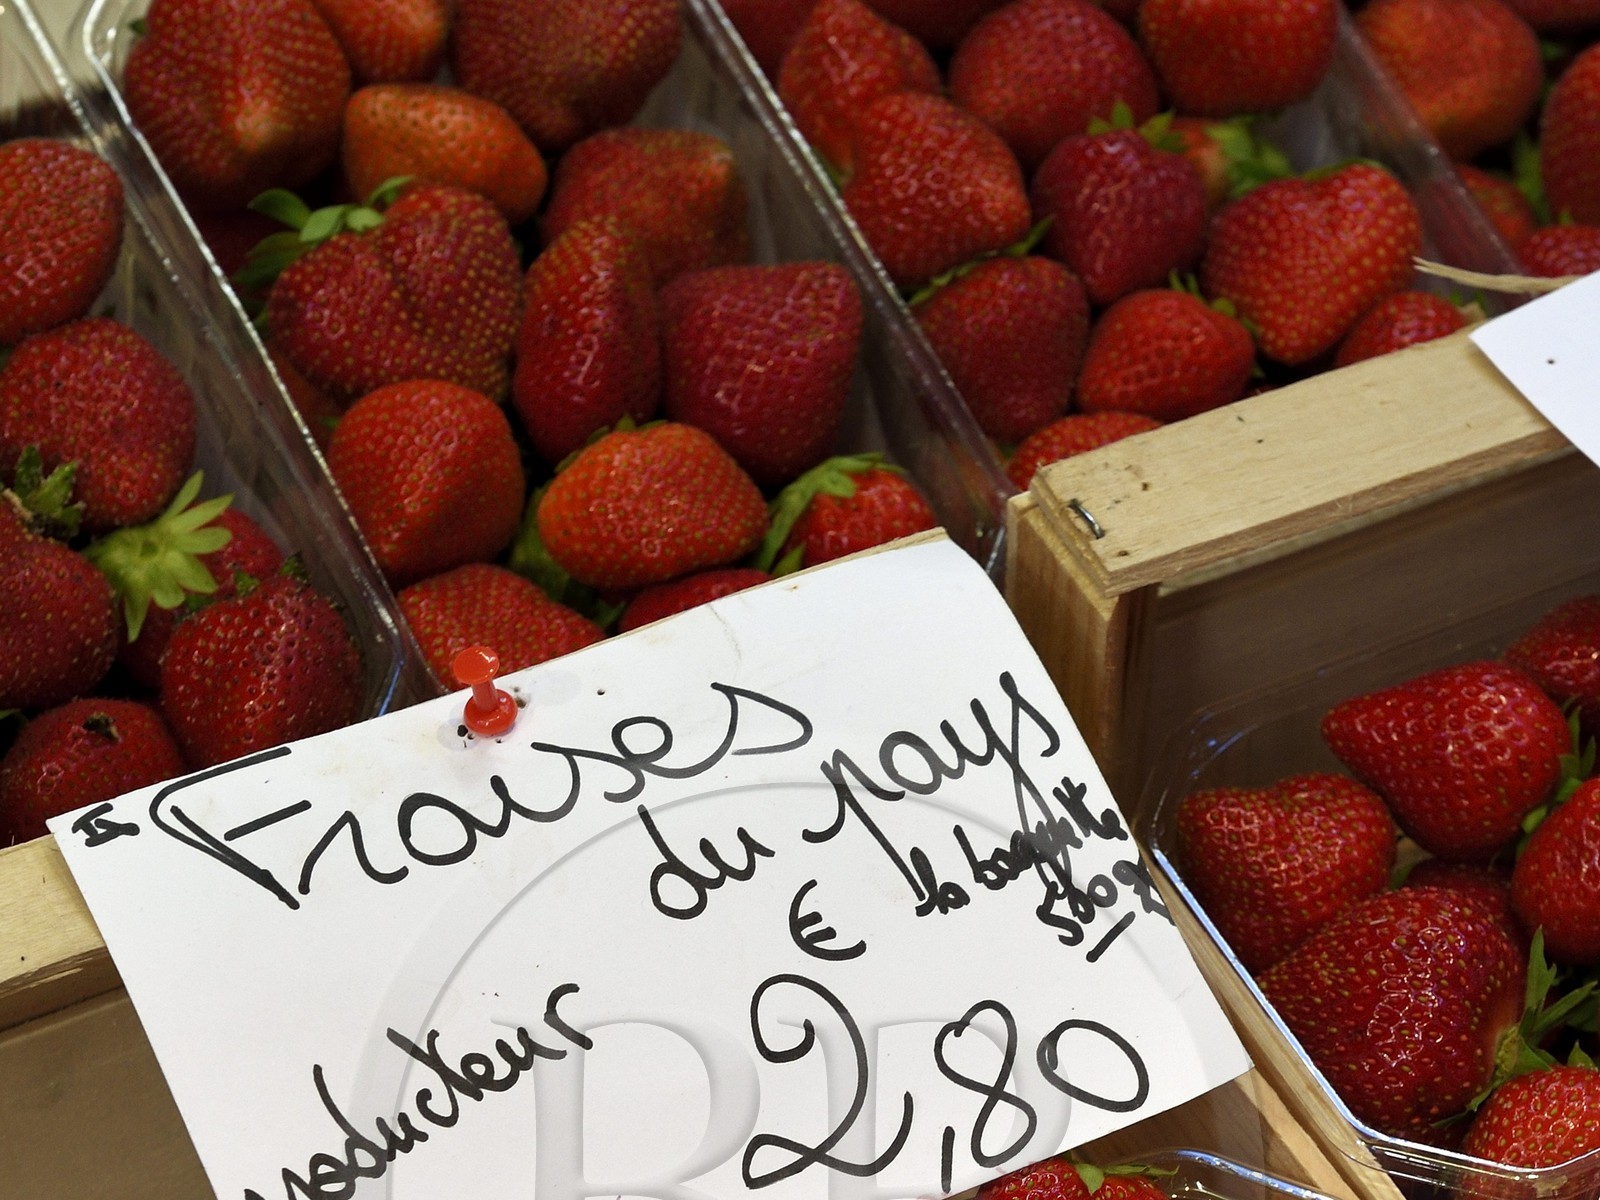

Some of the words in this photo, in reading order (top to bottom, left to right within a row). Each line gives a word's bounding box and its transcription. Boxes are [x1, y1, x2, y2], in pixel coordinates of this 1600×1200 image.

[149, 682, 812, 909] Fraises
[650, 805, 775, 920] du
[802, 671, 1060, 901] pays
[789, 880, 866, 961] €
[742, 974, 1149, 1193] 2,80
